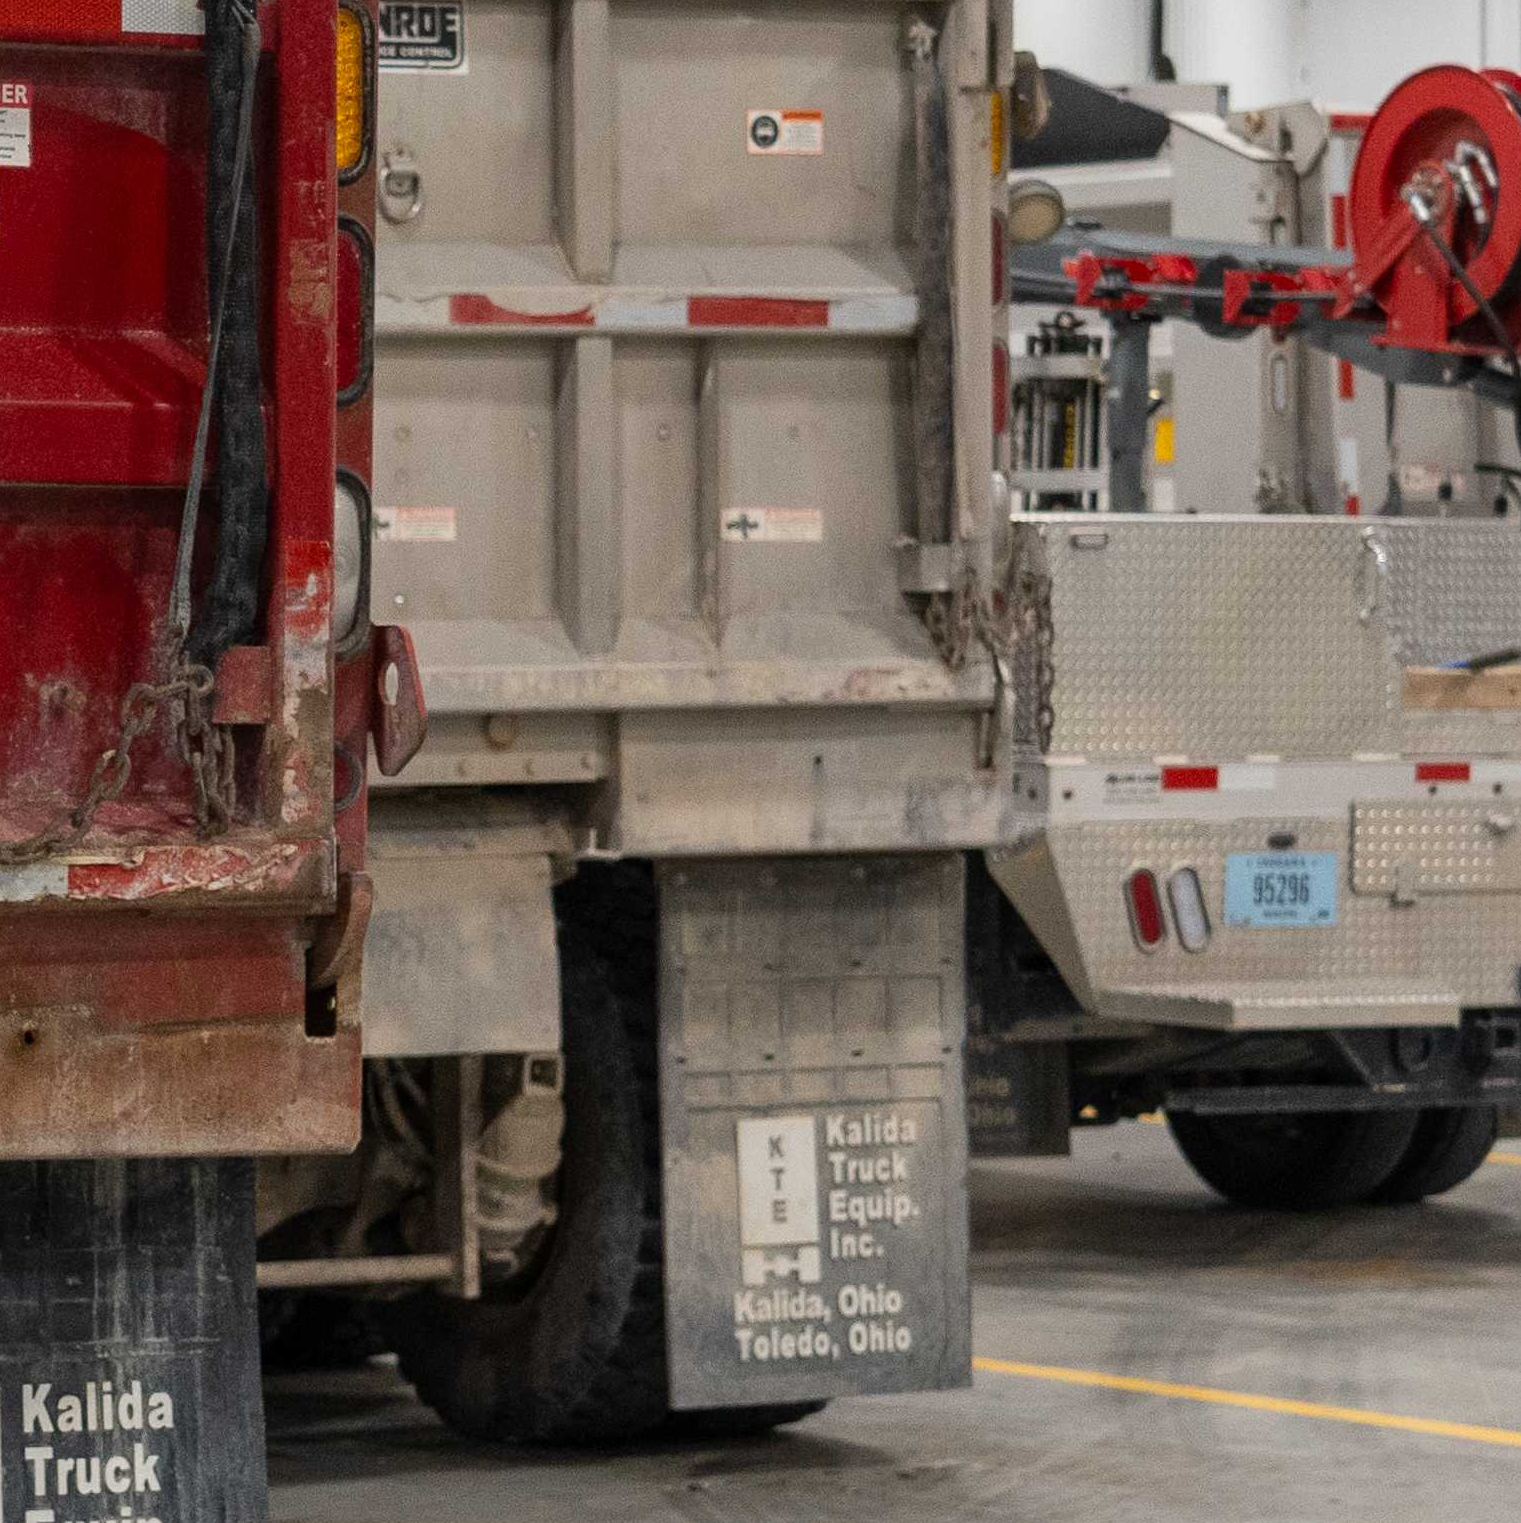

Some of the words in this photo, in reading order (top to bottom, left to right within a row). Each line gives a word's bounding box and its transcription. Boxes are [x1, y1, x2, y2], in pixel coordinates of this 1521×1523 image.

[379, 5, 459, 38] NROE
[1253, 872, 1310, 906] 95296
[825, 1113, 917, 1147] Kalida
[828, 1151, 908, 1184] Truck
[828, 1187, 921, 1227] Equip.
[829, 1228, 885, 1261] Inc.
[733, 1288, 832, 1324] Kalida,
[837, 1283, 903, 1318] Ohio
[734, 1325, 841, 1361] Toledo,
[848, 1320, 912, 1355] Ohio
[21, 1380, 174, 1434] Kalida
[24, 1443, 161, 1497] Truck
